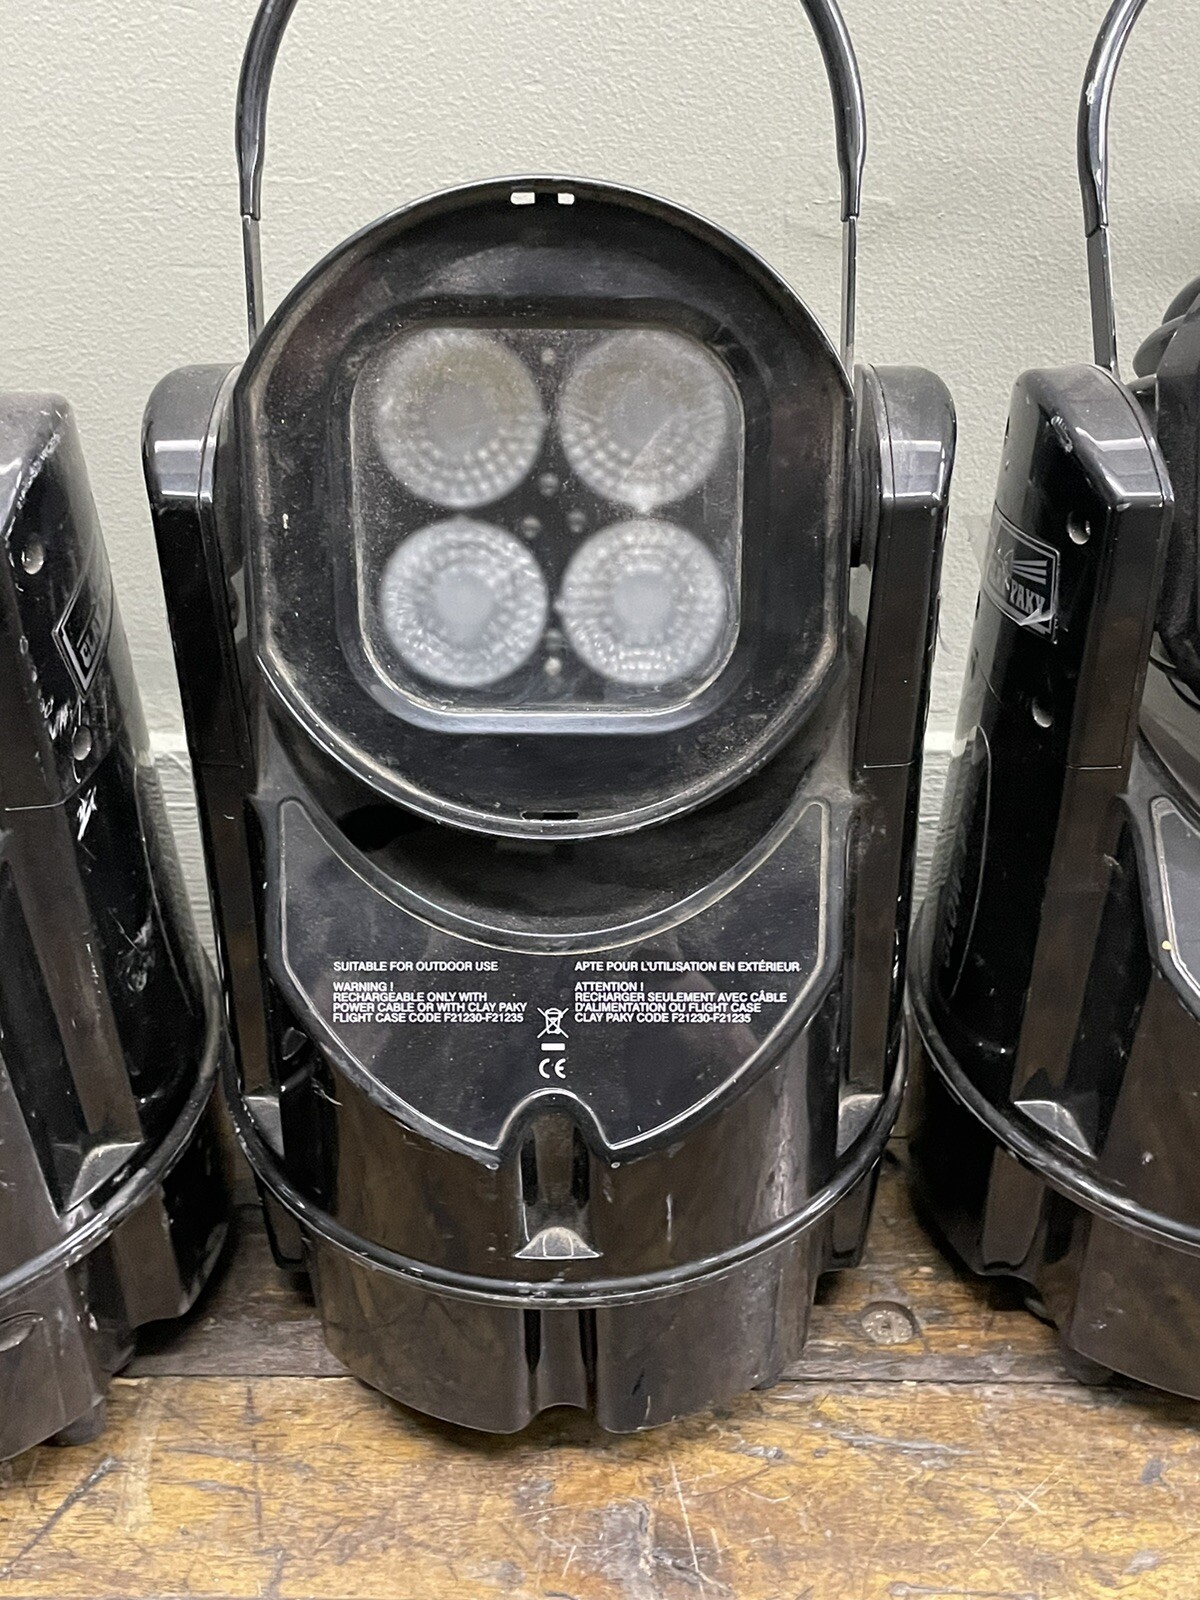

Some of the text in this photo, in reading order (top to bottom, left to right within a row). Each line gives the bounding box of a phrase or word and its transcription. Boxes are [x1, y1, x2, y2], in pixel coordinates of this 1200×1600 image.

[332, 960, 499, 972] SUITABLE FOR OUTDOOR USE
[574, 958, 802, 972] APTE POUR L'UTILISATION EN EXTÉRIEUR
[332, 981, 388, 992] WARNING
[574, 981, 638, 992] ATTENTION
[332, 992, 488, 1002] RECHARGEABLE ONLY WITH
[574, 992, 646, 1002] RECHARGER
[647, 992, 717, 1002] SEULEMENT
[716, 992, 748, 1002] AVEC
[332, 1002, 528, 1012] POWER CABLE OR WITH CLAY PAKY
[574, 1002, 762, 1012] D'ALIMENTATION OU FLIGHT CASE
[332, 1012, 524, 1023] FLIGHT CASE CODE F21230-F21235
[574, 1012, 752, 1023] CLAY PAKY CODE F21230-F21235
[538, 1057, 567, 1079] CE
